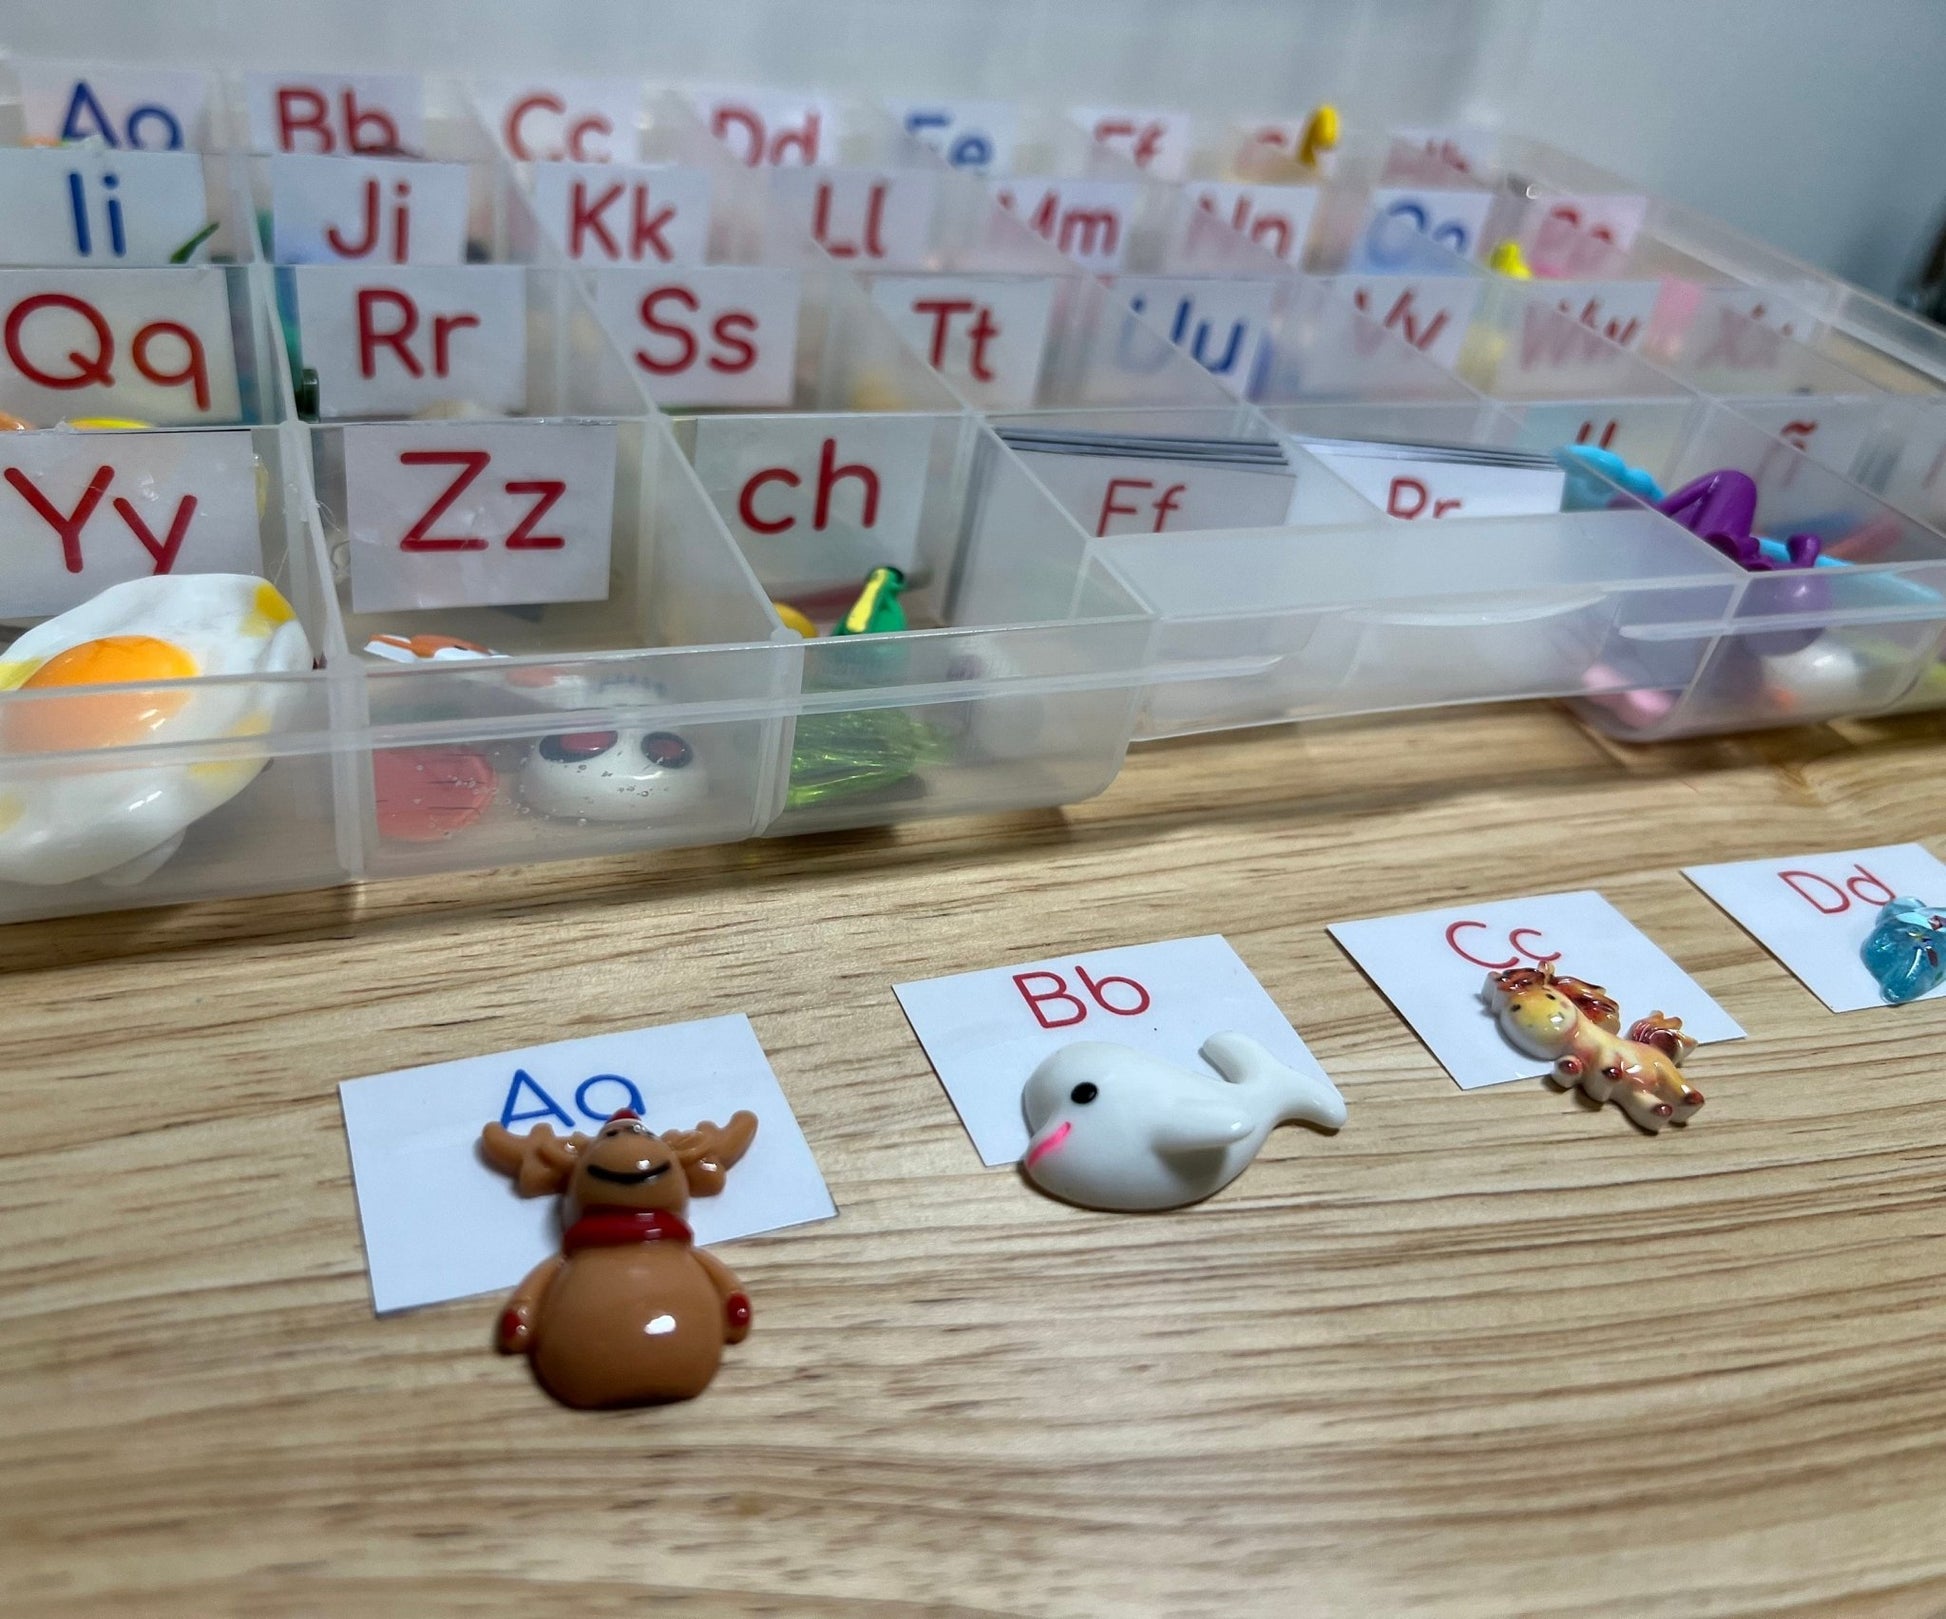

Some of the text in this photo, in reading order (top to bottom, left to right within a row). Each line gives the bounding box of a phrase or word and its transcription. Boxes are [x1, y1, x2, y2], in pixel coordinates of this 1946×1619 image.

[504, 93, 610, 161] Cc
[568, 182, 674, 262] Kk
[812, 182, 886, 260] Ll
[4, 293, 211, 411] Qq
[355, 287, 479, 378] Rr
[635, 286, 758, 376] Ss
[914, 299, 1000, 383] Tt
[2, 464, 198, 574] Yy
[399, 450, 567, 553] Zz
[737, 438, 881, 535] ch
[1097, 480, 1185, 537] Ff
[1778, 865, 1896, 914] Dd
[1445, 921, 1562, 968] Cc
[1012, 965, 1152, 1030] Bb
[500, 1069, 646, 1129] Aa
